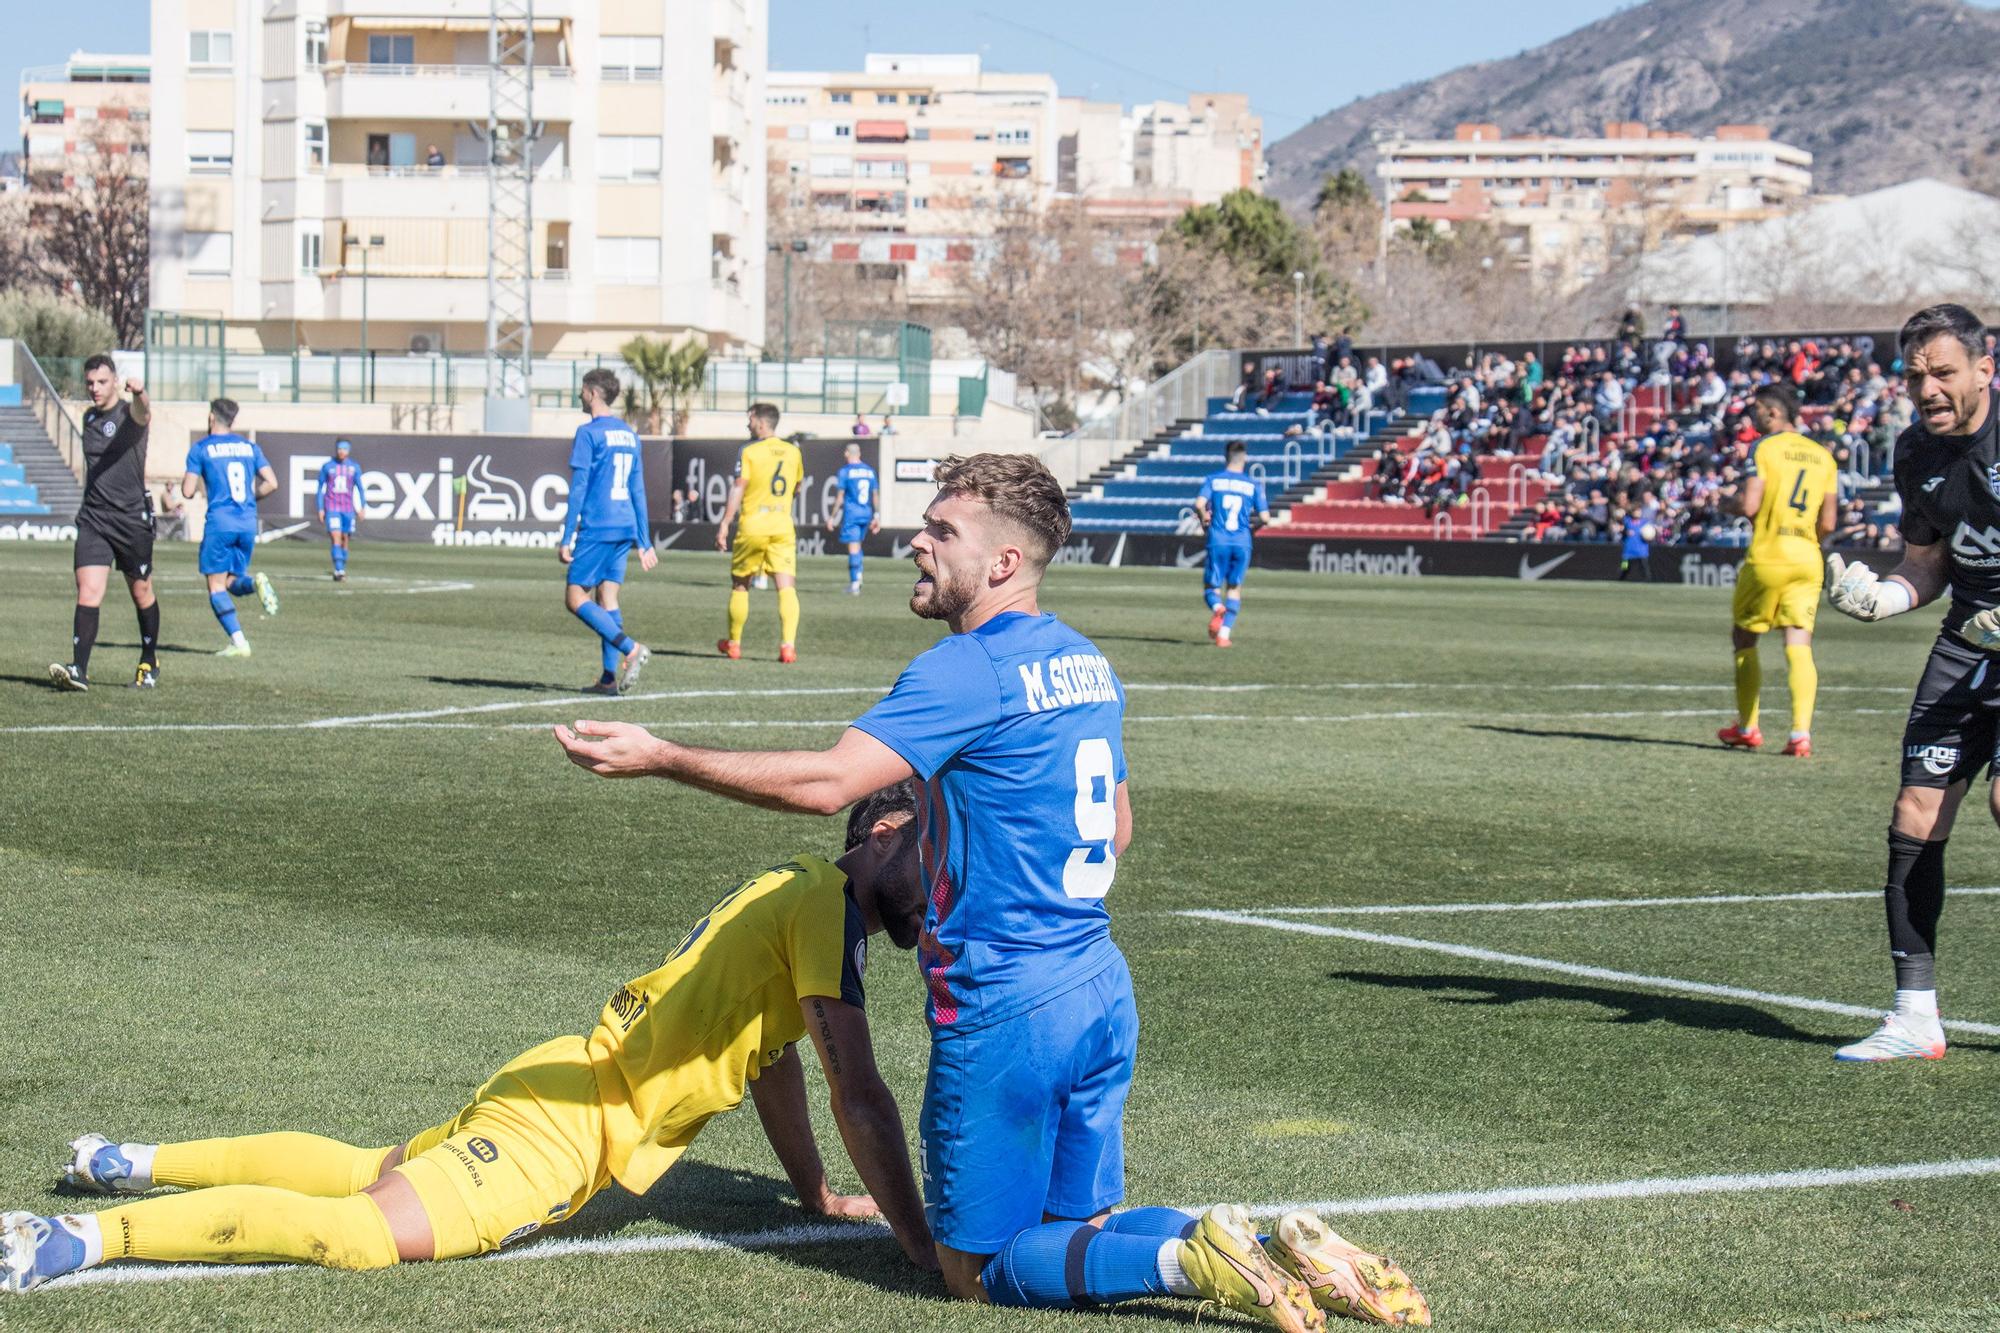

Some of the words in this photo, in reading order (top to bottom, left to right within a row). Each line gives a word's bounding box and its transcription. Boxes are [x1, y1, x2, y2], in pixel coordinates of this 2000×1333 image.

[227, 461, 246, 503] 8
[771, 461, 787, 497] 6
[1789, 468, 1808, 512] 4
[1222, 494, 1243, 532] 7
[1308, 544, 1423, 578] finetwork
[1063, 738, 1117, 898] 9
